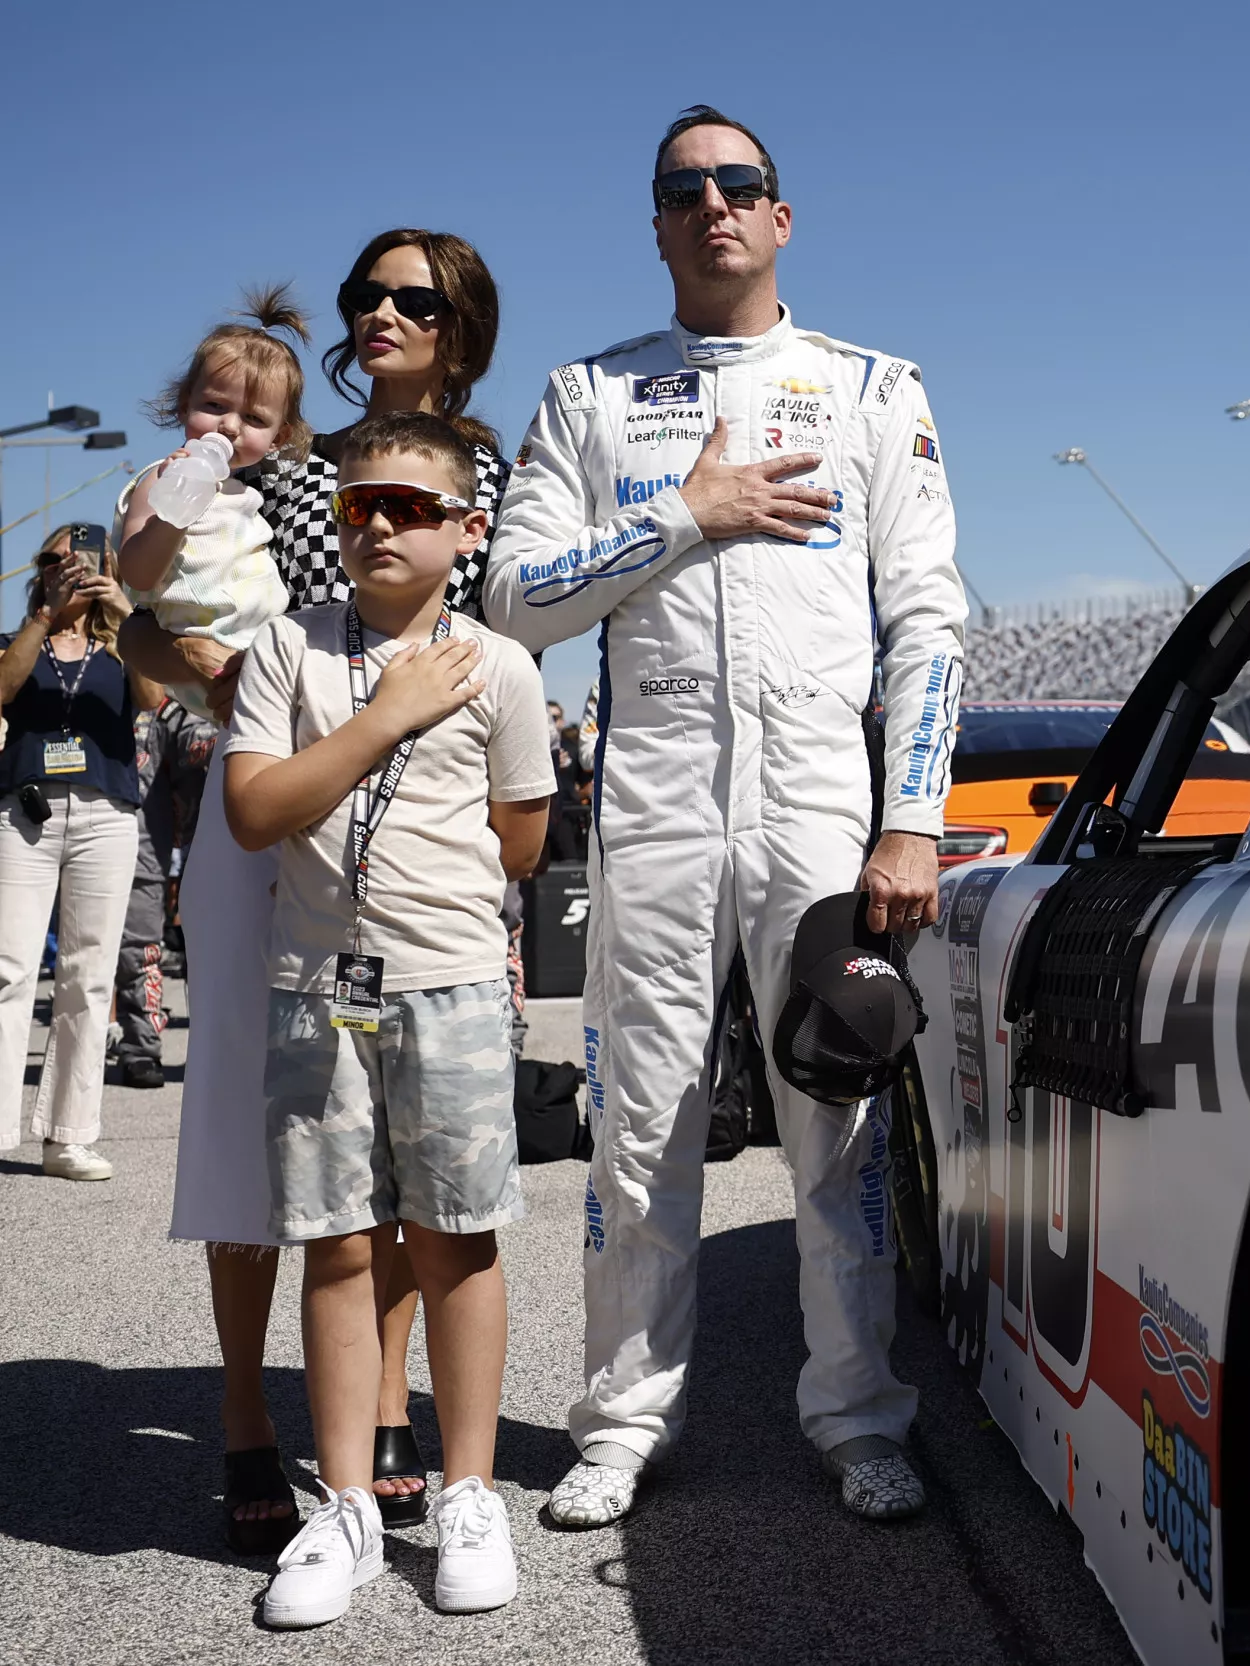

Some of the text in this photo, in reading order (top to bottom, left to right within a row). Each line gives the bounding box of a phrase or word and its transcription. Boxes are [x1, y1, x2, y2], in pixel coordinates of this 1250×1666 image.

[643, 381, 688, 396] xfinity
[875, 362, 902, 404] sparco
[760, 408, 818, 424] RACING
[764, 396, 820, 412] KAULIG
[519, 516, 657, 583] KaugCompanies
[348, 604, 361, 652] CUP SERI
[639, 677, 699, 696] sparco
[959, 705, 1123, 713] LIGERMA
[900, 651, 947, 797] KauligCompanies
[380, 753, 406, 798] SERIES
[356, 873, 367, 901] CUP
[561, 899, 590, 925] 5
[343, 1021, 364, 1030] MINOR
[955, 1010, 977, 1038] COMETIC
[1138, 1263, 1209, 1363] KauligCompanies
[1143, 1398, 1209, 1519] DaaBIN
[1143, 1457, 1211, 1594] STORE
